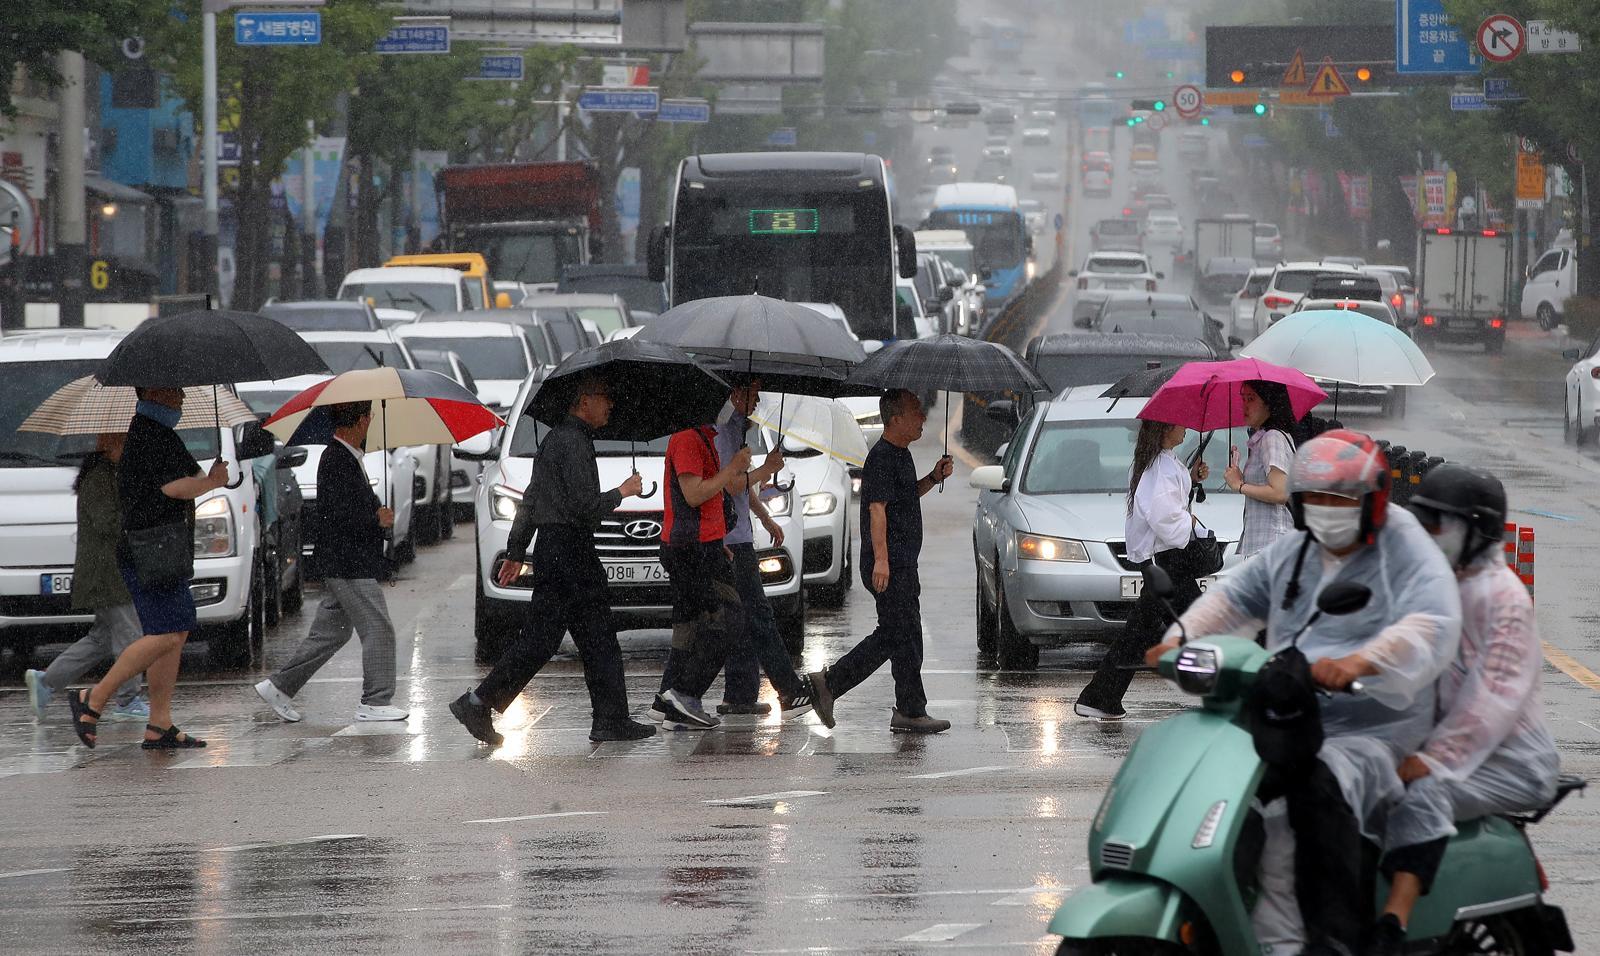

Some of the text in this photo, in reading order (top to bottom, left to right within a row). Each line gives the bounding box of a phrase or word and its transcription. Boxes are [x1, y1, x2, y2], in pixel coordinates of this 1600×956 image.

[1419, 13, 1449, 28] 중앙버
[1419, 30, 1458, 44] 전용차로
[1432, 49, 1446, 64] 끝
[1181, 93, 1196, 106] 50
[958, 213, 993, 225] 111-1
[90, 260, 110, 290] 6
[607, 566, 635, 580] 08마
[1130, 579, 1145, 595] 1
